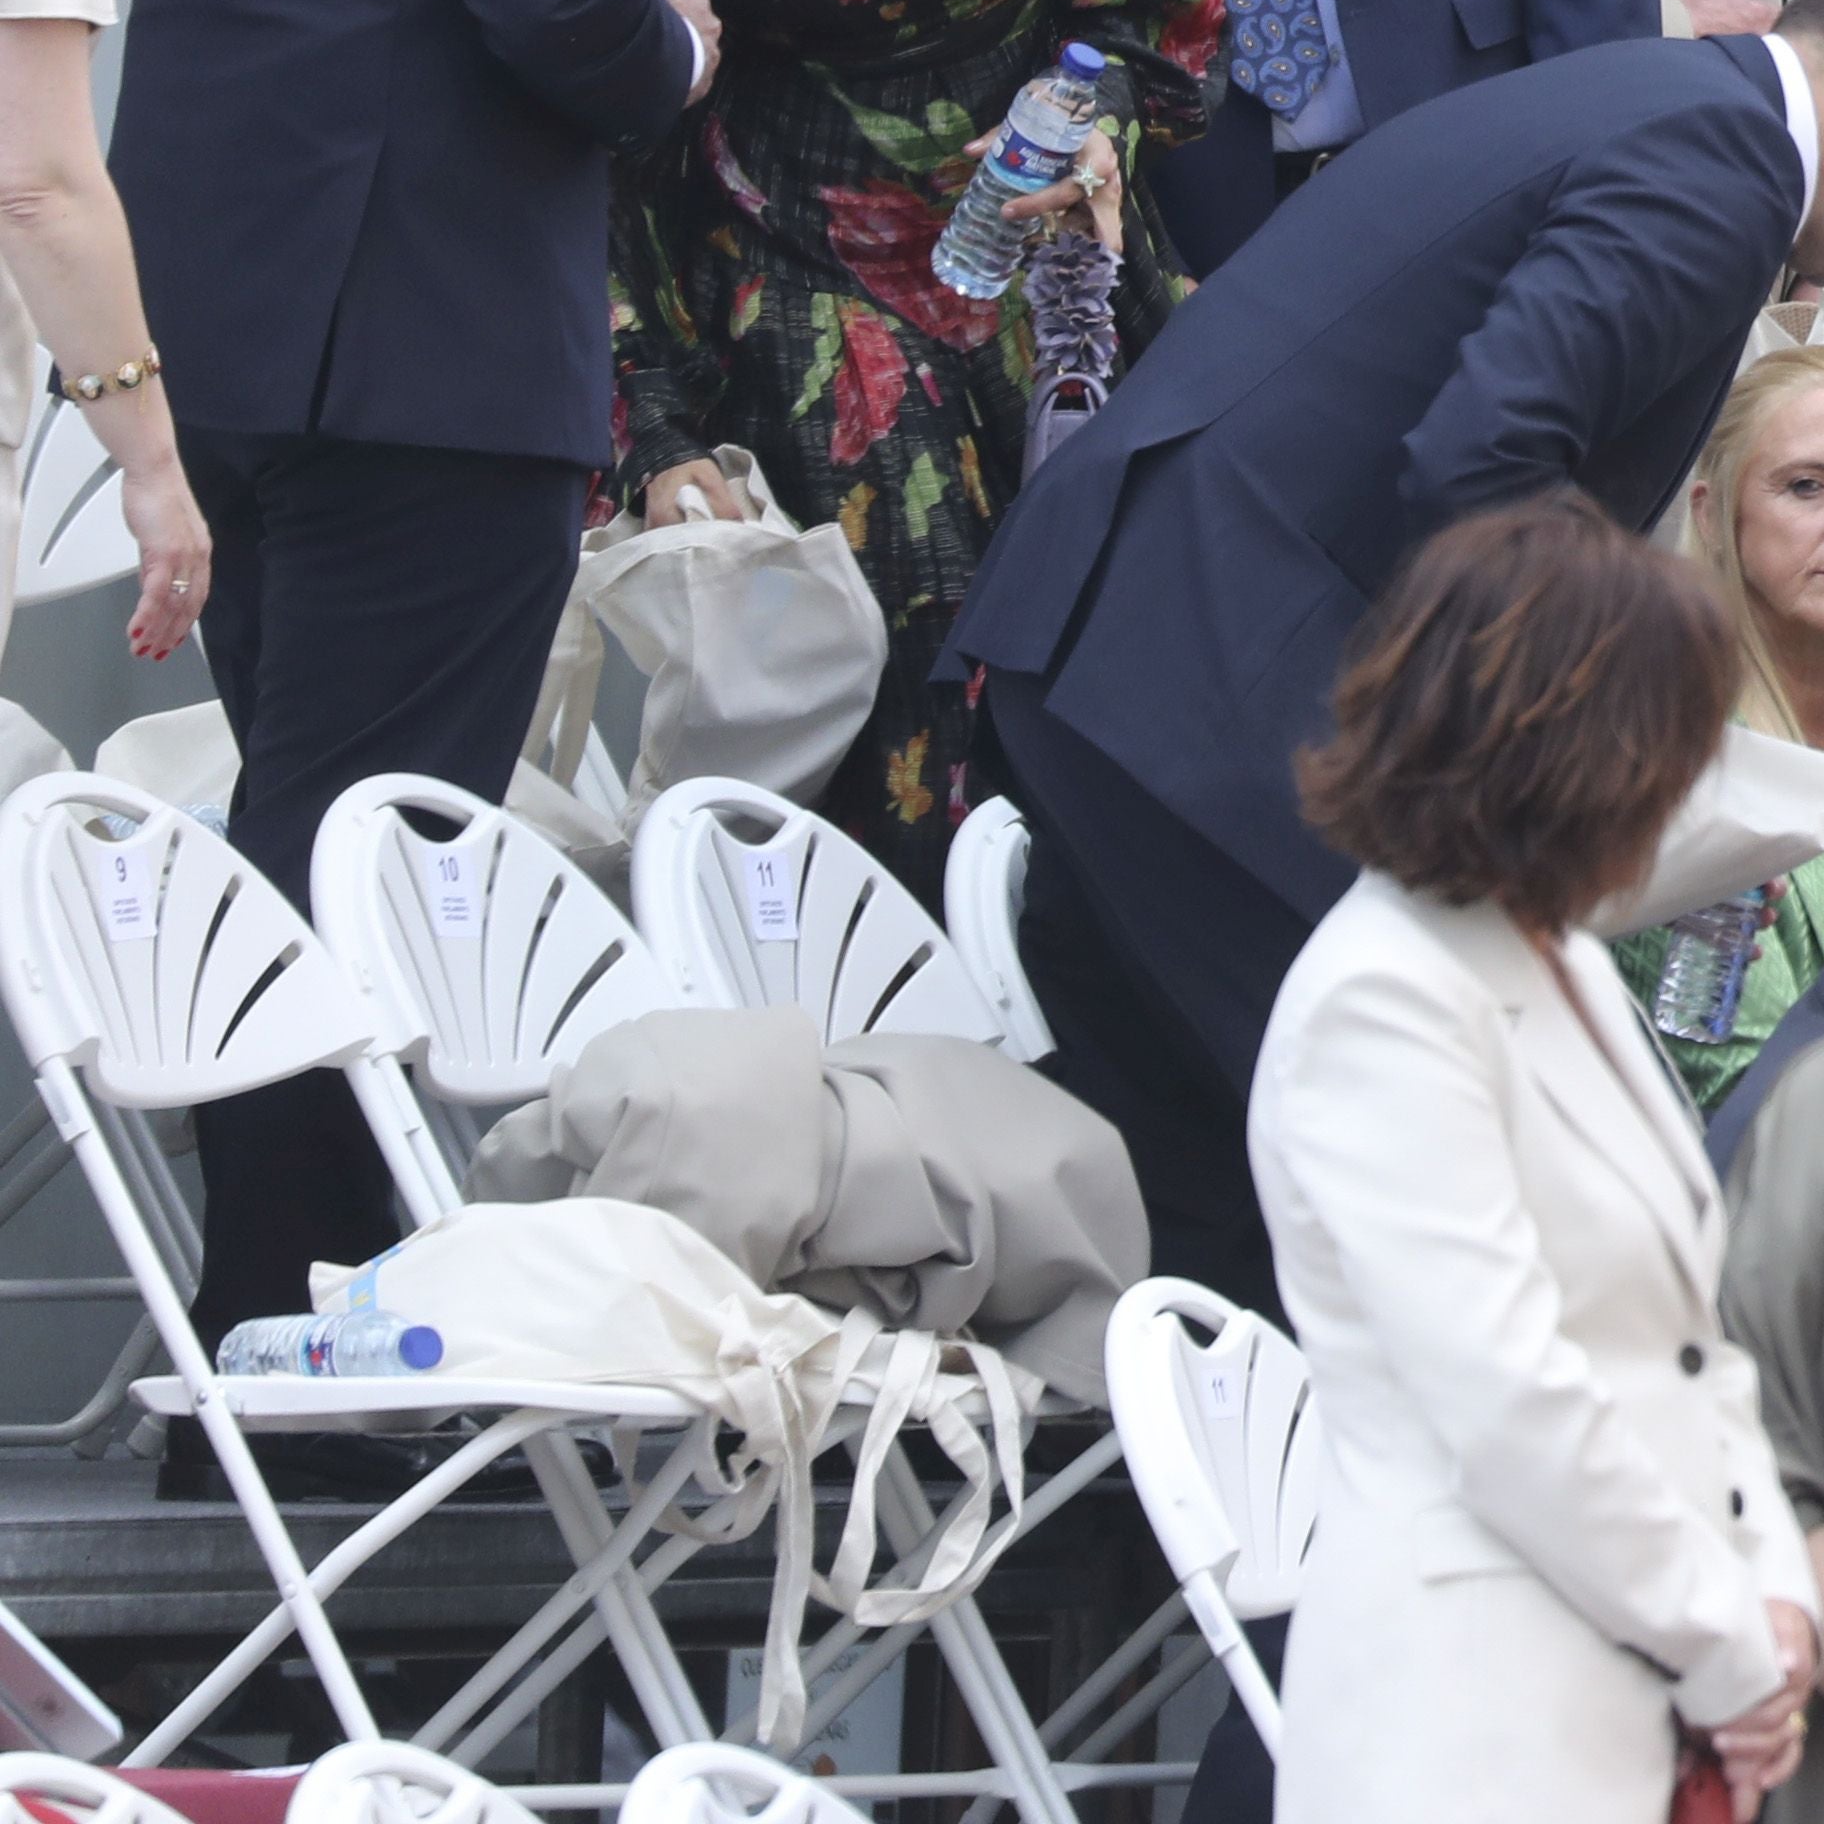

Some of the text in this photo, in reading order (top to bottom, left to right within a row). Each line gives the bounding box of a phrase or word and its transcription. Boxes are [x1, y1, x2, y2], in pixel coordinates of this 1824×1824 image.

[115, 856, 127, 882] 9
[438, 856, 459, 882] 10
[756, 861, 775, 887] 11
